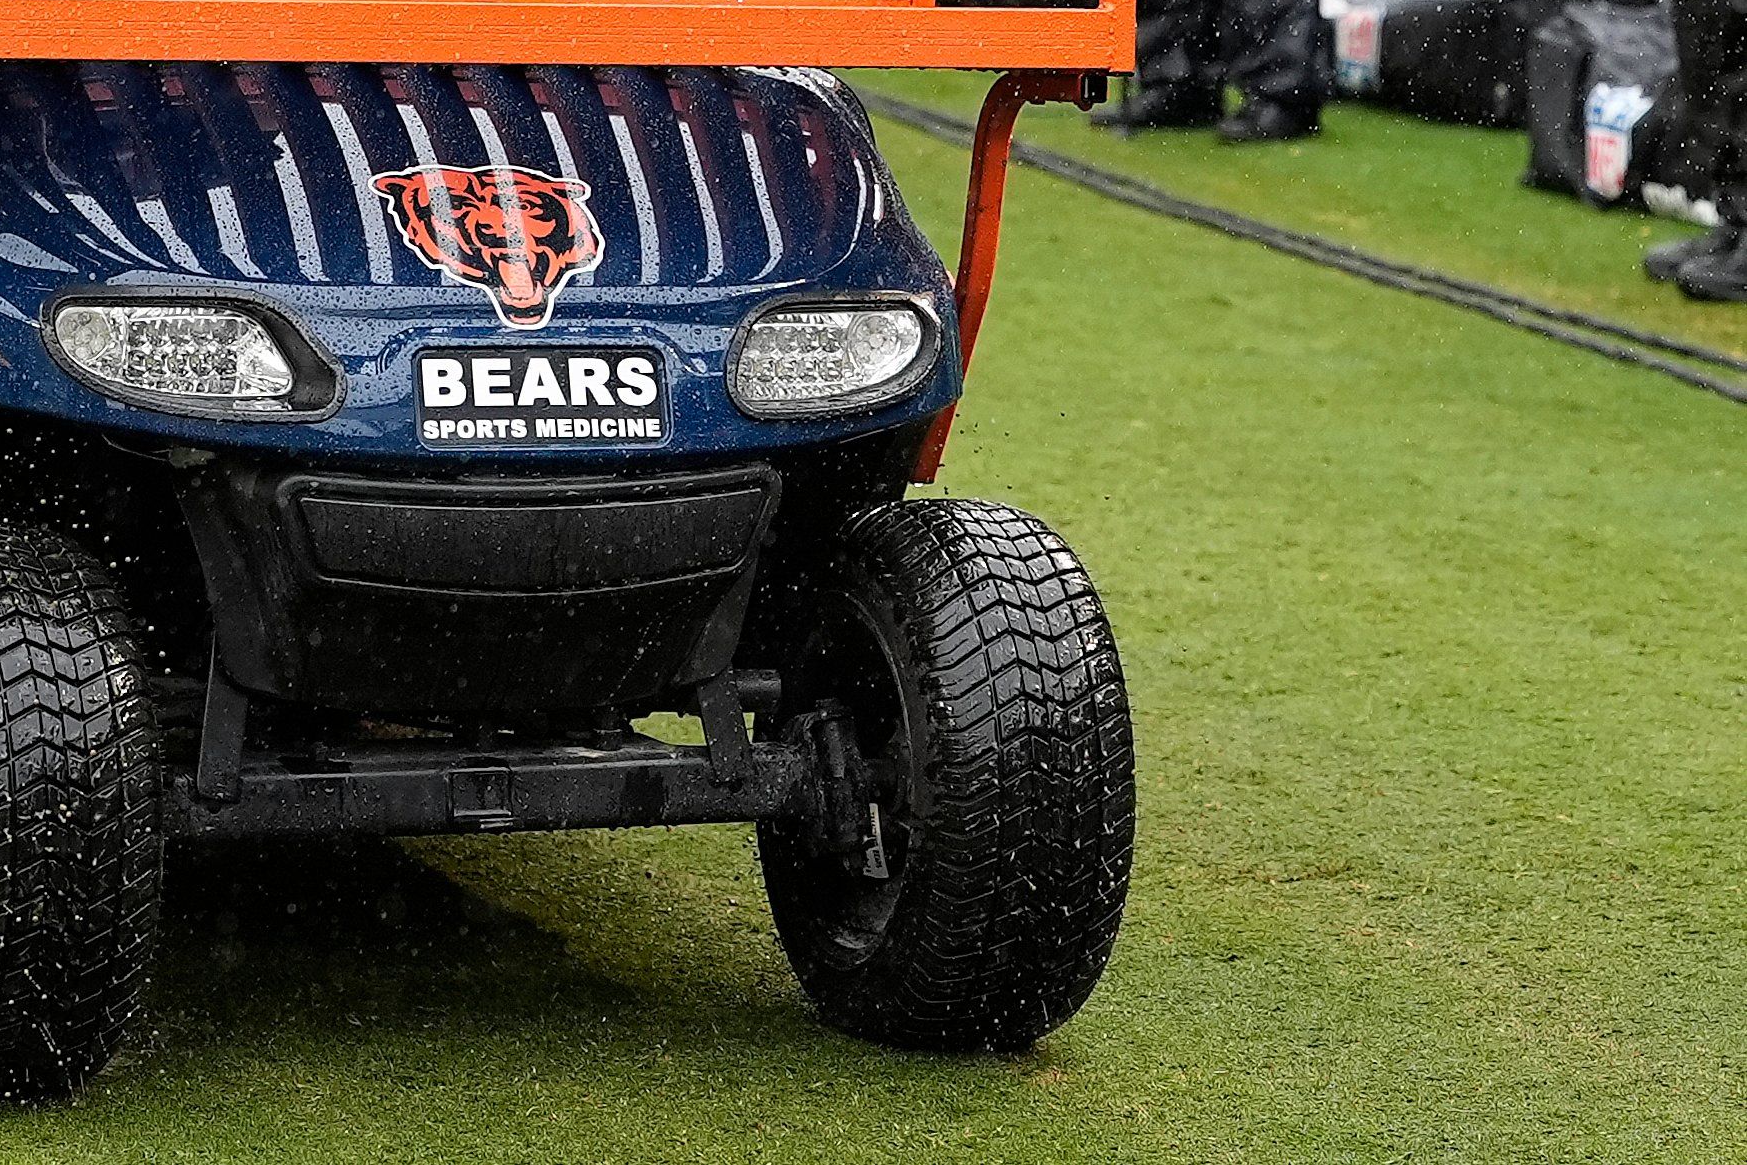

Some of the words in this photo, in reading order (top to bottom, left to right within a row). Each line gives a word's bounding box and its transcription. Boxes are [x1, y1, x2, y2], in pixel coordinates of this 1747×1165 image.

[421, 357, 658, 408] BEARS
[423, 419, 528, 440] SPORTS
[535, 418, 662, 438] MEDICINE
